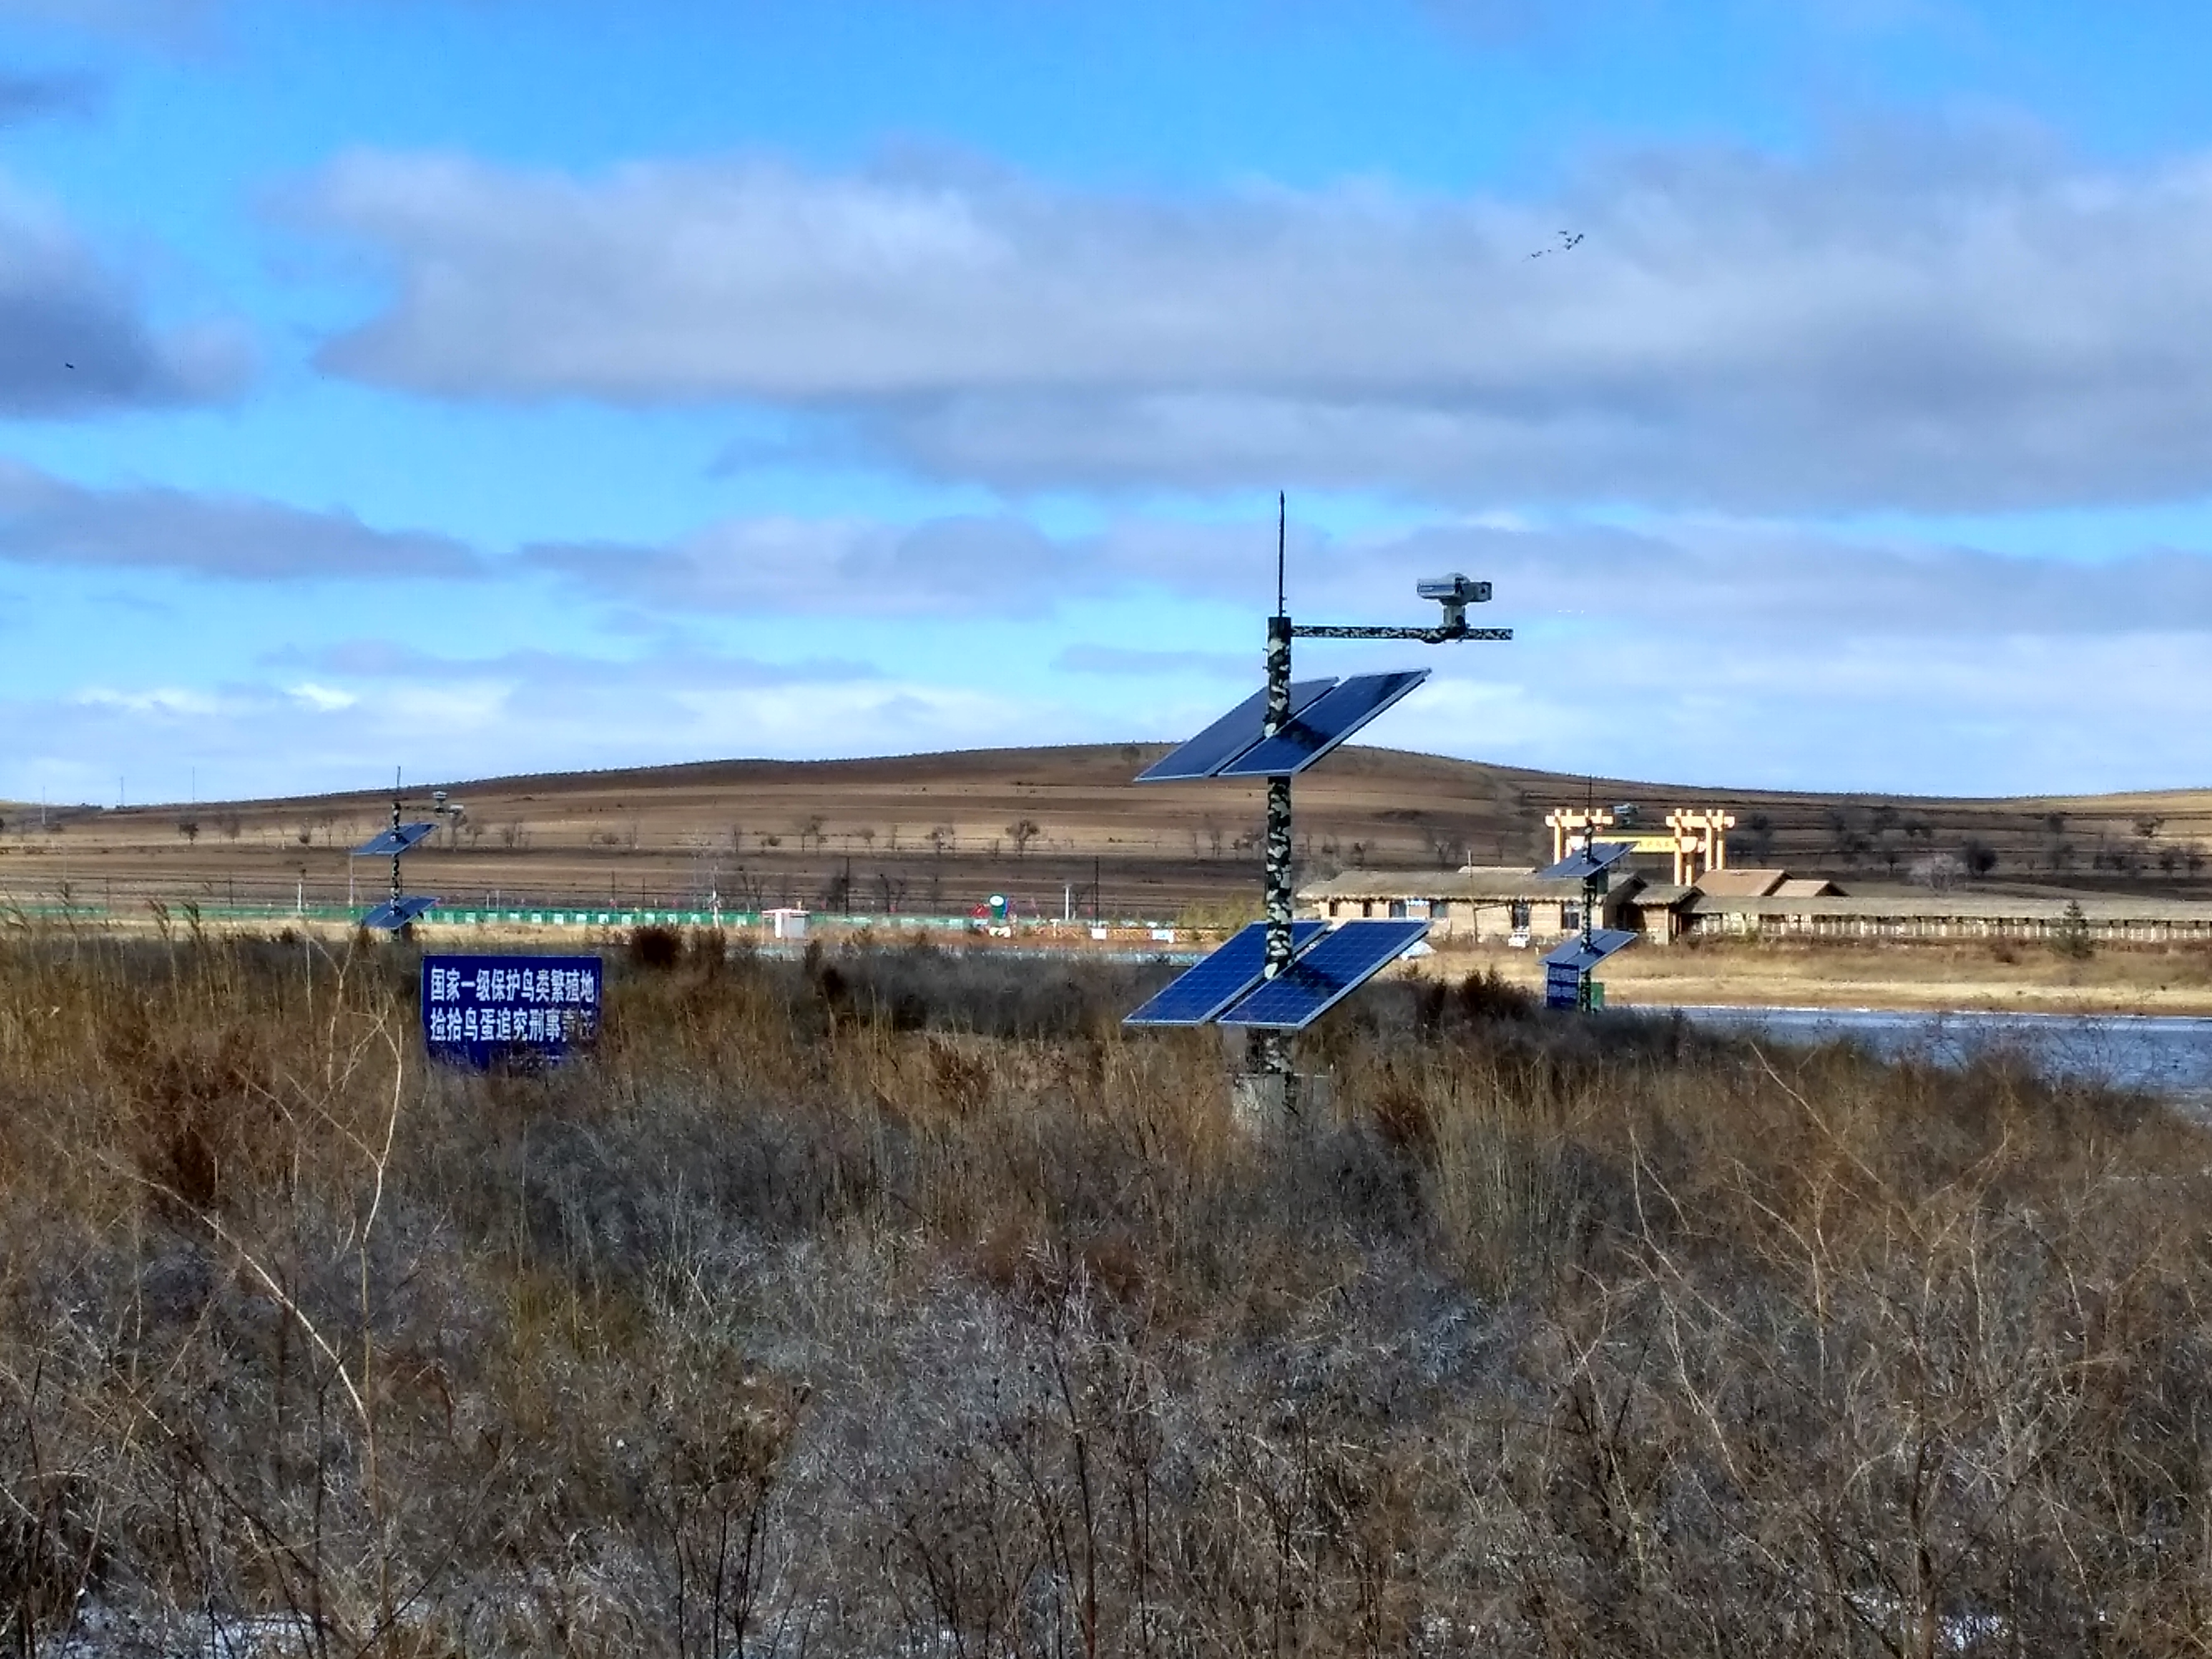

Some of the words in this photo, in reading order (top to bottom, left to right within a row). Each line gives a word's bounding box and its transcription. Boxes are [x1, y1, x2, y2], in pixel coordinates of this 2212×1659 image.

[431, 968, 594, 1003] 国家一级保护鸟类繁殖地
